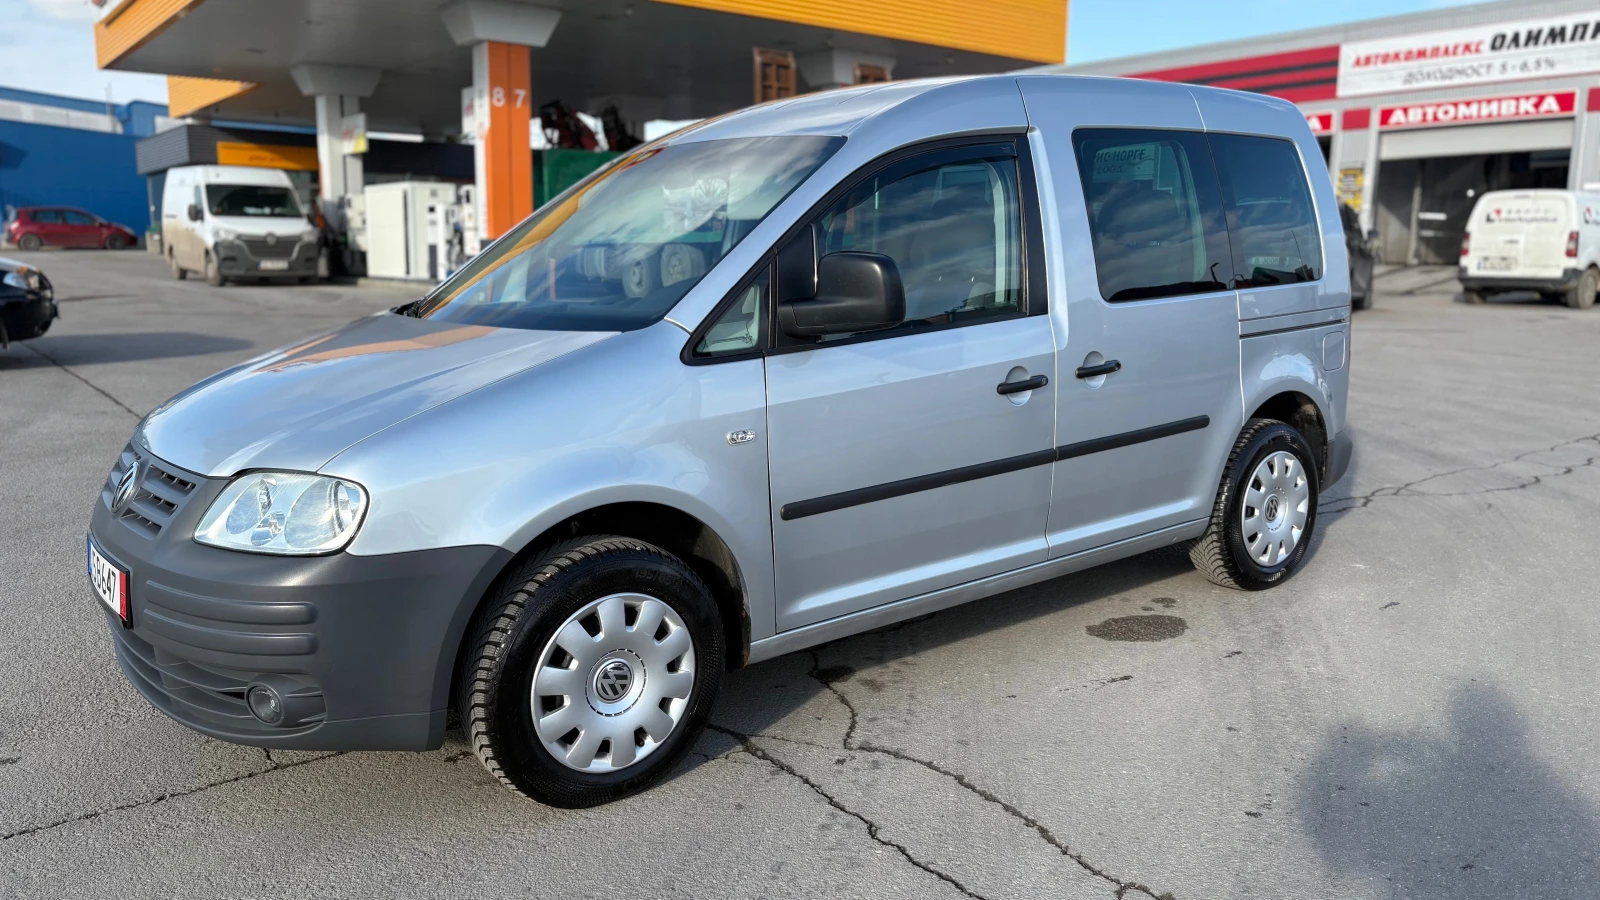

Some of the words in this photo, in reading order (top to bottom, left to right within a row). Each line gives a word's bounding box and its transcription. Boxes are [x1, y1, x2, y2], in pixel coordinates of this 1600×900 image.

[1352, 41, 1484, 68] АВТОКОМПЛЕКС
[492, 87, 506, 107] 8
[514, 89, 527, 108] 7
[1388, 95, 1561, 125] АВТОМИВКА
